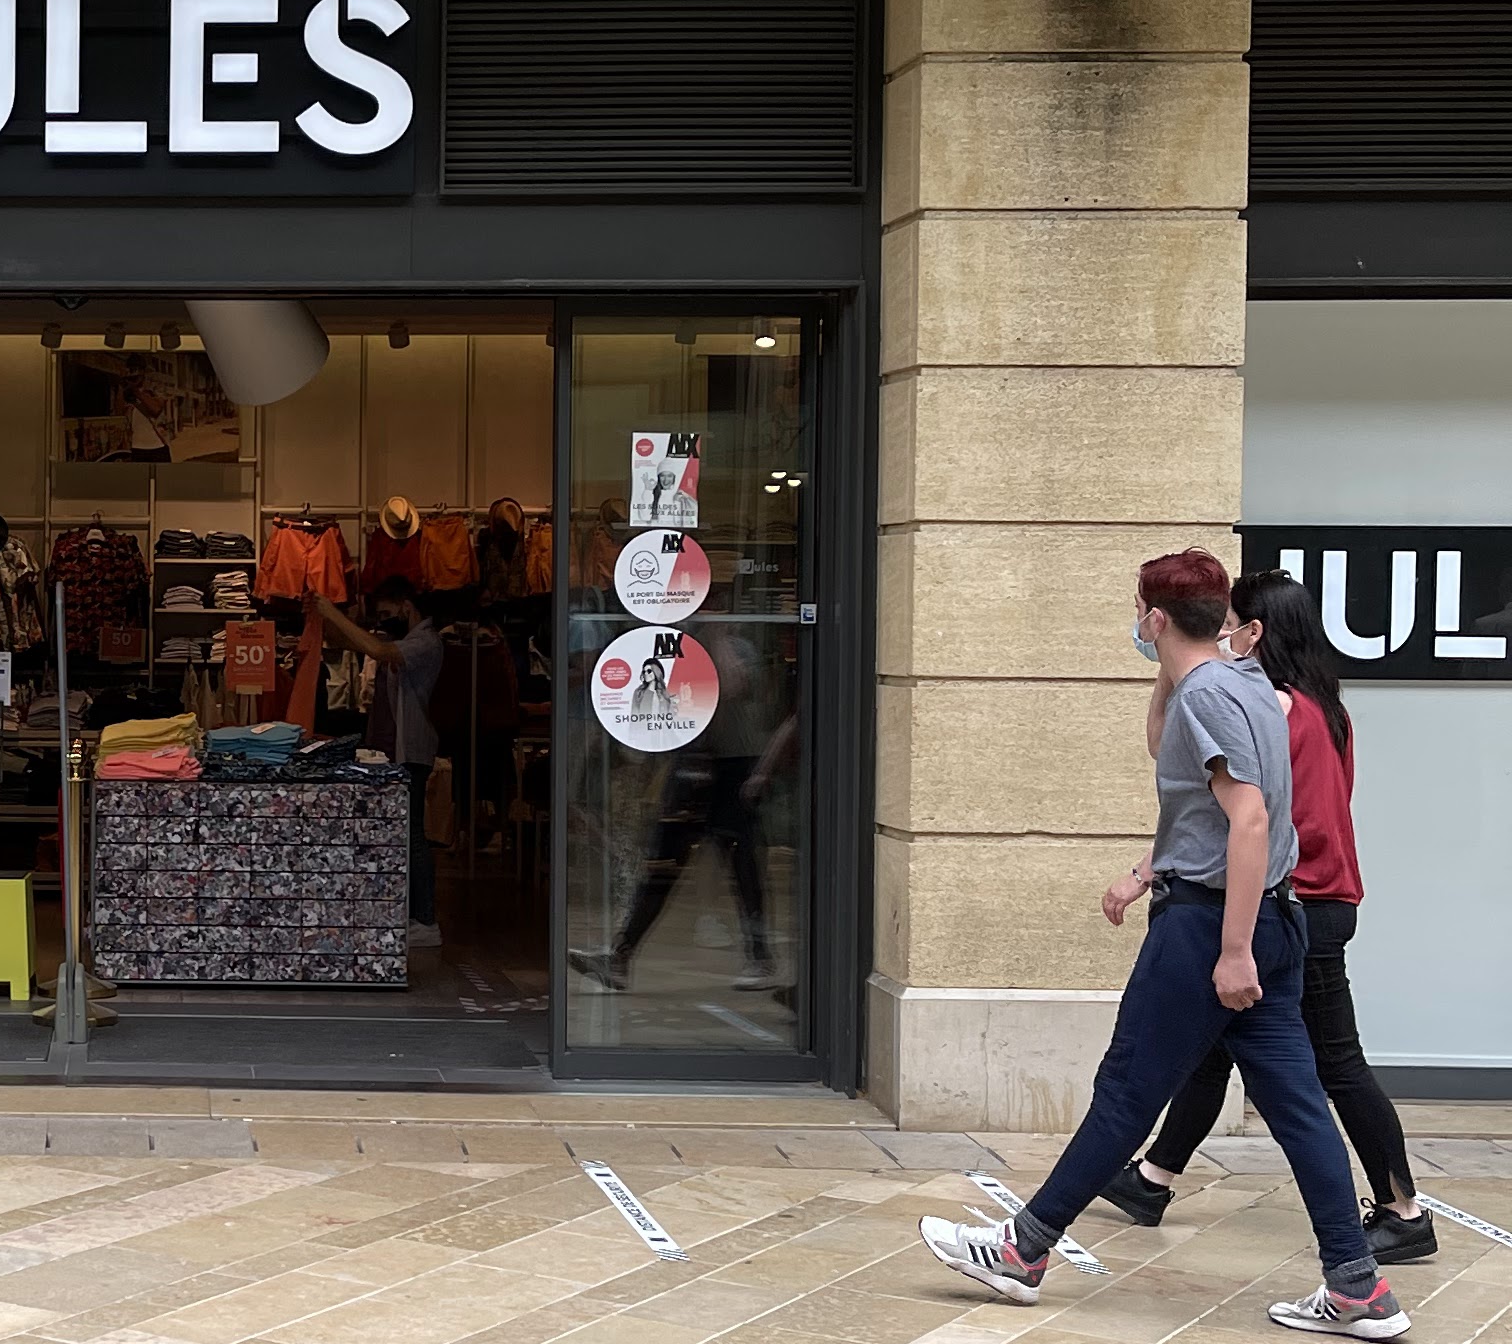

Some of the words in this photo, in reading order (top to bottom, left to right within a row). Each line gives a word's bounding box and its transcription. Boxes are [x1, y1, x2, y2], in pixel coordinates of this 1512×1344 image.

[741, 560, 779, 575] Jules
[646, 597, 690, 605] OBLIGATOIRE
[1279, 549, 1507, 660] UL
[615, 712, 674, 724] SHOPPING
[647, 722, 662, 731] EN
[666, 720, 695, 730] VILLE
